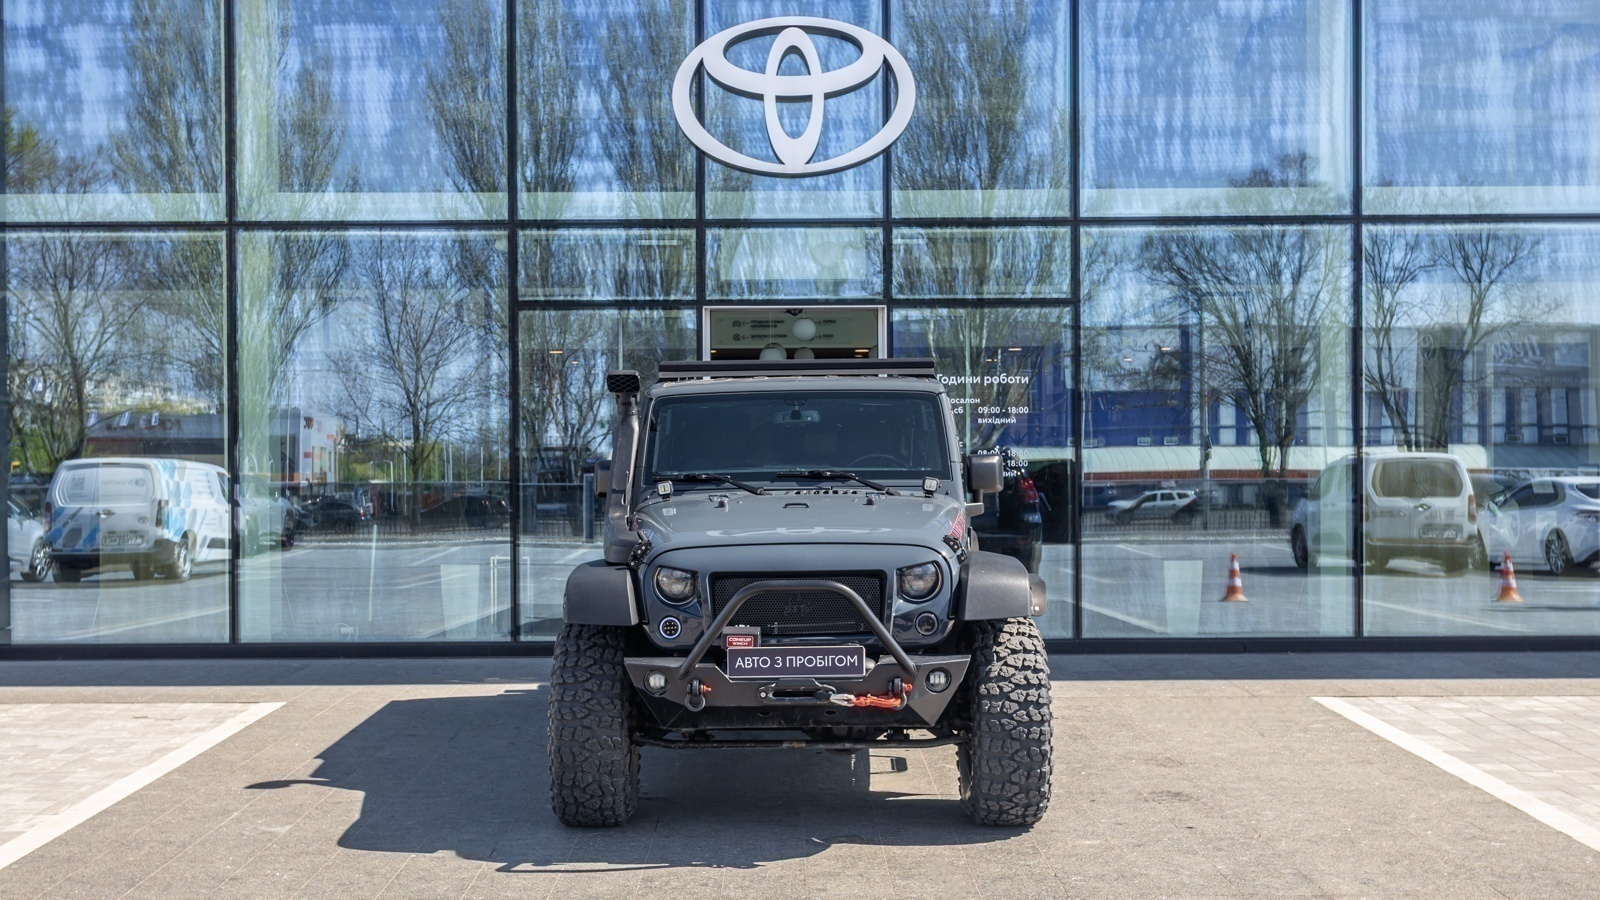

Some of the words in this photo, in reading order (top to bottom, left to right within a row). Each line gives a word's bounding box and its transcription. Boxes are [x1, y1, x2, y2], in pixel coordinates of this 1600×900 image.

[936, 373, 981, 386] Години
[983, 373, 1029, 387] роботи
[977, 406, 1000, 414] 09:00
[1007, 406, 1029, 414] 18:00
[977, 416, 1017, 424] вихідний
[1007, 449, 1029, 457] 18:00
[1007, 459, 1029, 467] 18:00
[735, 656, 771, 669] АВТО
[774, 656, 783, 668] З
[786, 655, 858, 668] ПРОБІГОМ
